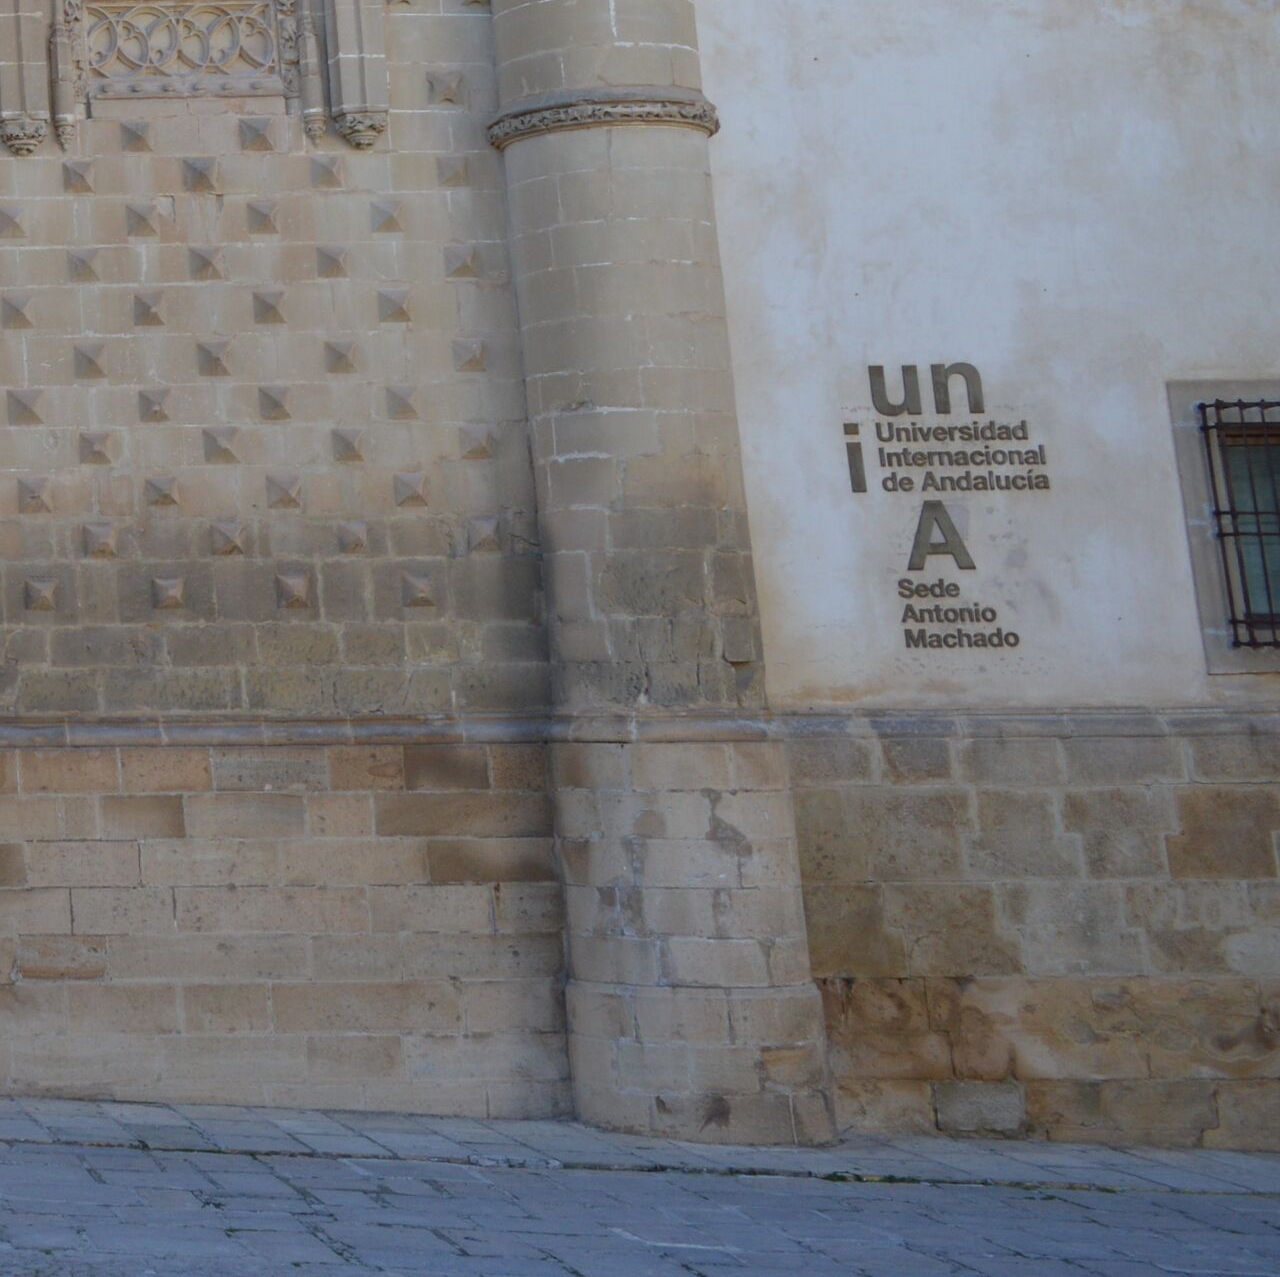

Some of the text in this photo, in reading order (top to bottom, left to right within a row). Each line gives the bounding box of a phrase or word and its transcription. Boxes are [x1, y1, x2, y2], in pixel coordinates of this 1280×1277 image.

[875, 420, 1028, 442] Universidad
[879, 445, 1046, 467] Internacional
[882, 469, 1050, 492] de Andalucía
[907, 500, 976, 571] A
[898, 579, 960, 599] Sede
[902, 603, 996, 623] Antonio
[904, 628, 1019, 648] Machado
